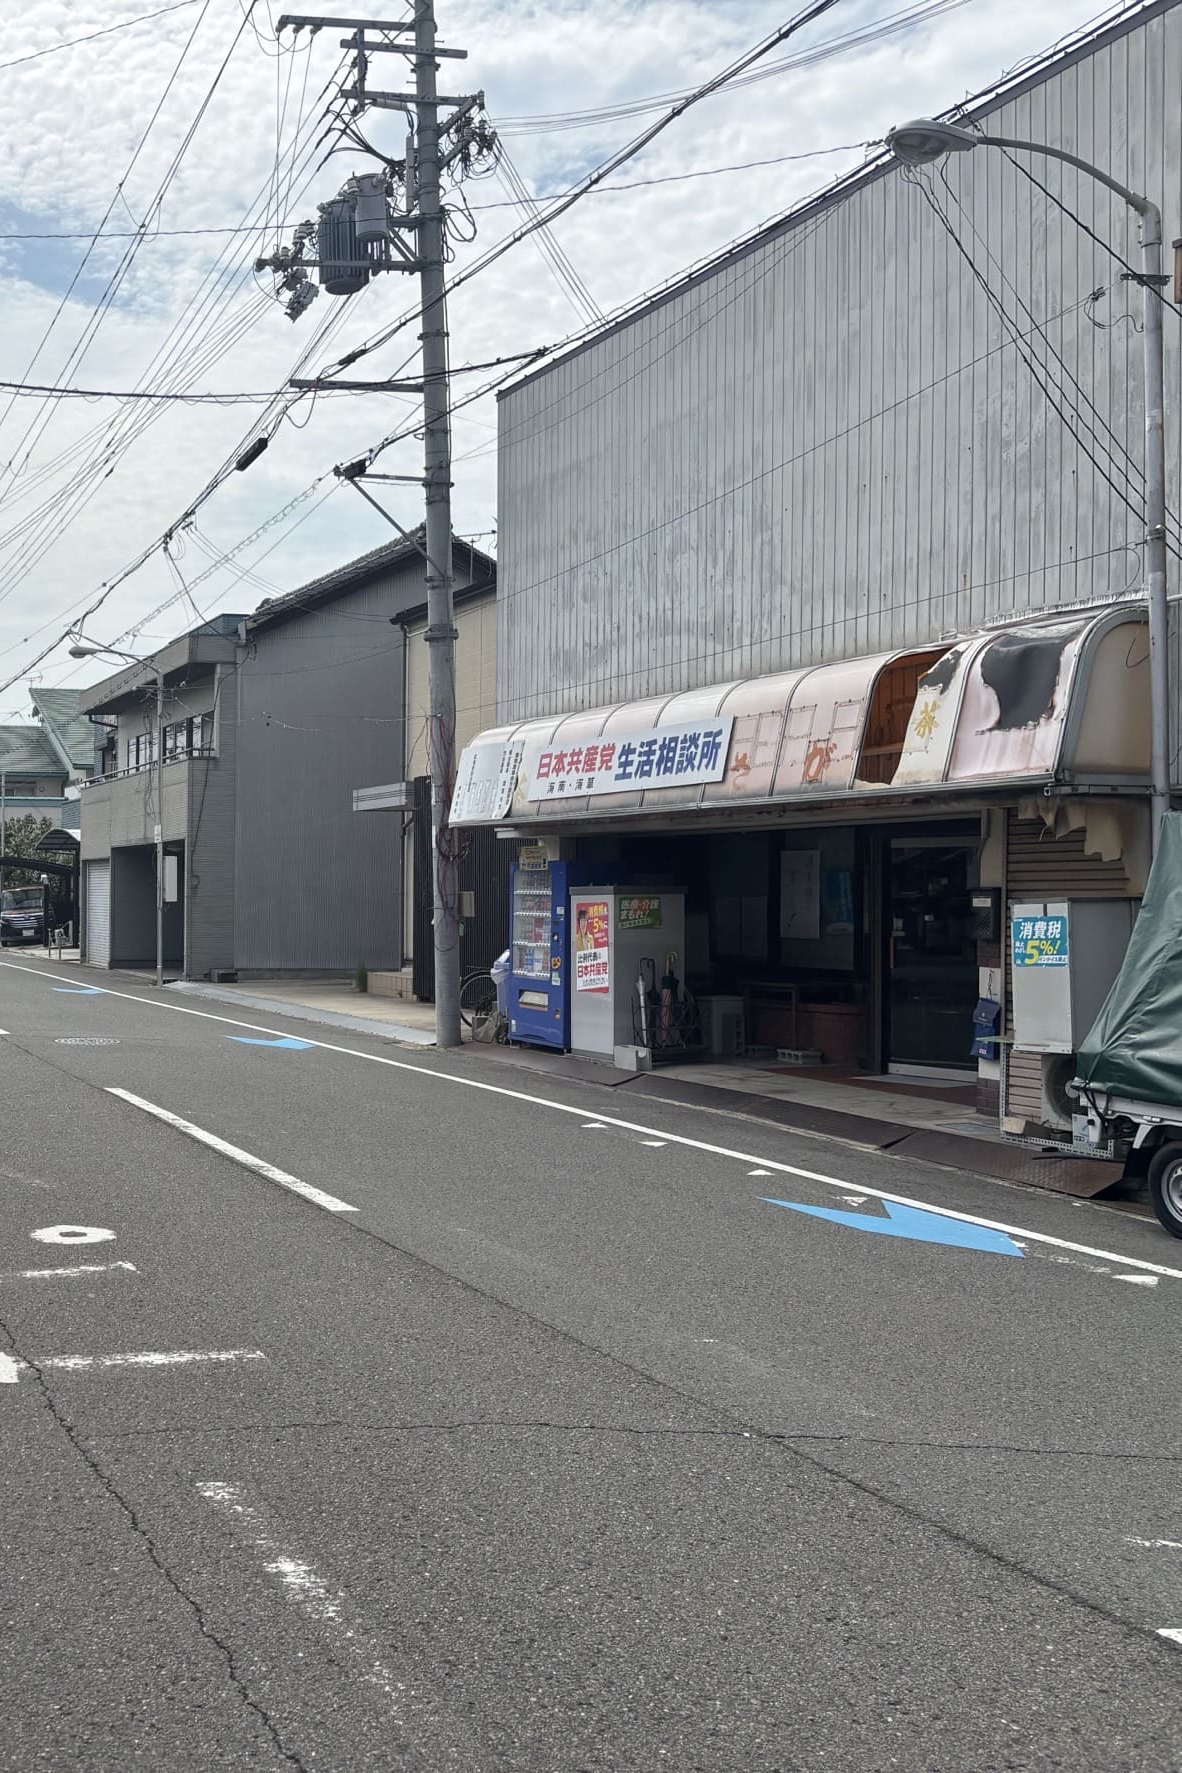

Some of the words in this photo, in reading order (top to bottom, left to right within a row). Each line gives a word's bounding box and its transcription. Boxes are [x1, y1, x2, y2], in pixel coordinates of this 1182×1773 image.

[536, 742, 616, 780] 日本共産党
[614, 729, 723, 781] 生活相談所
[1019, 920, 1062, 939] 消費税
